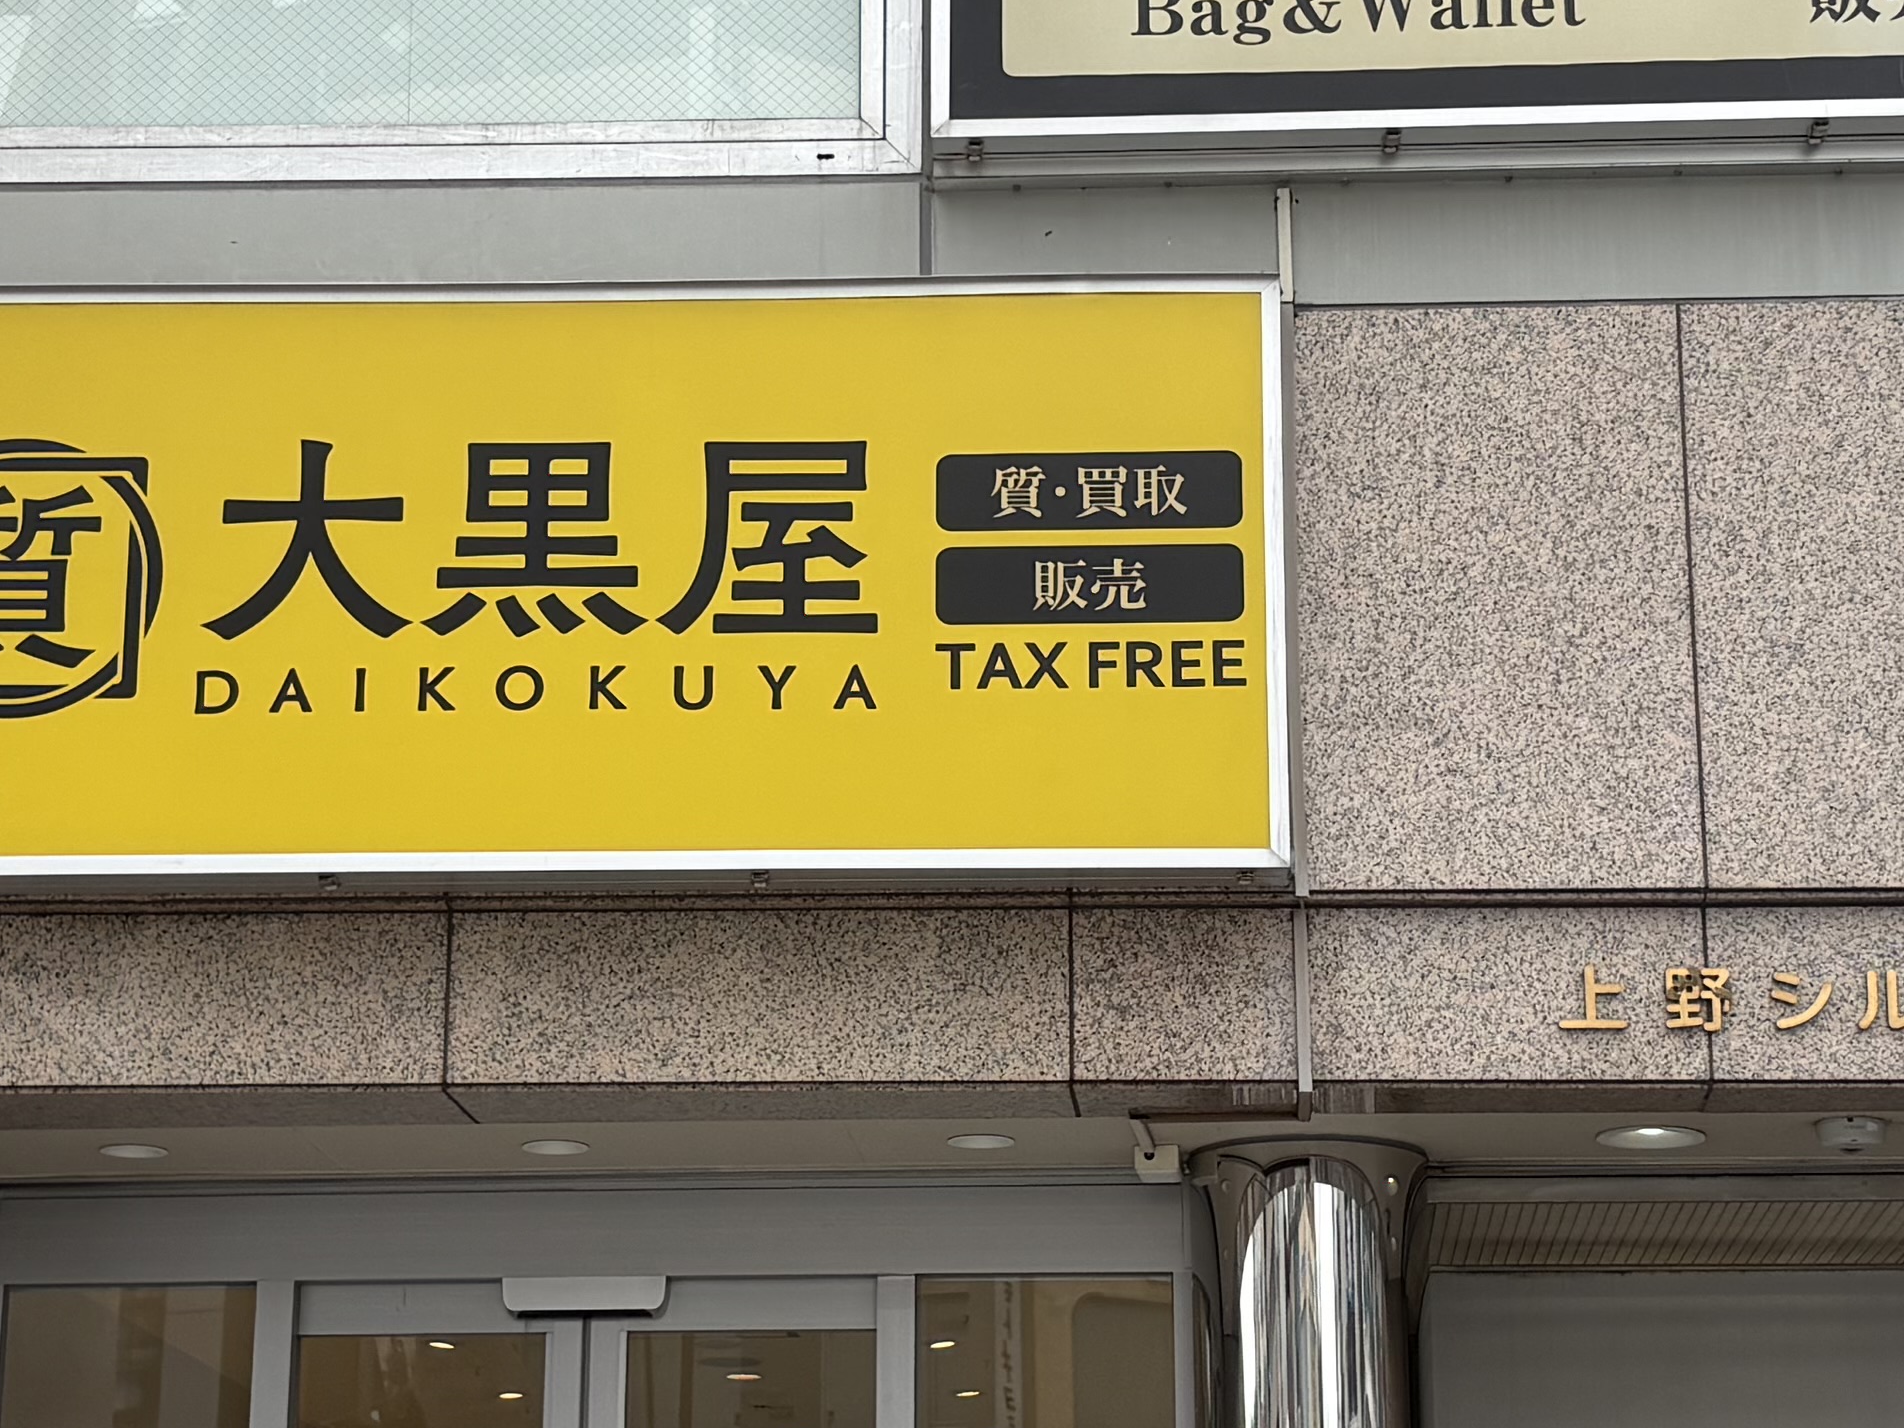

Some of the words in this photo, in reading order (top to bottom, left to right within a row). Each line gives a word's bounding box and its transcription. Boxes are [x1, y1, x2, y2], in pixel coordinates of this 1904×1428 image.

[990, 463, 1189, 520] 質・買取
[203, 438, 882, 642] 大黒屋
[1030, 558, 1151, 612] 販売
[193, 661, 880, 719] DAIKOKUYA
[934, 640, 1066, 692] TAX
[1087, 638, 1250, 690] FREE
